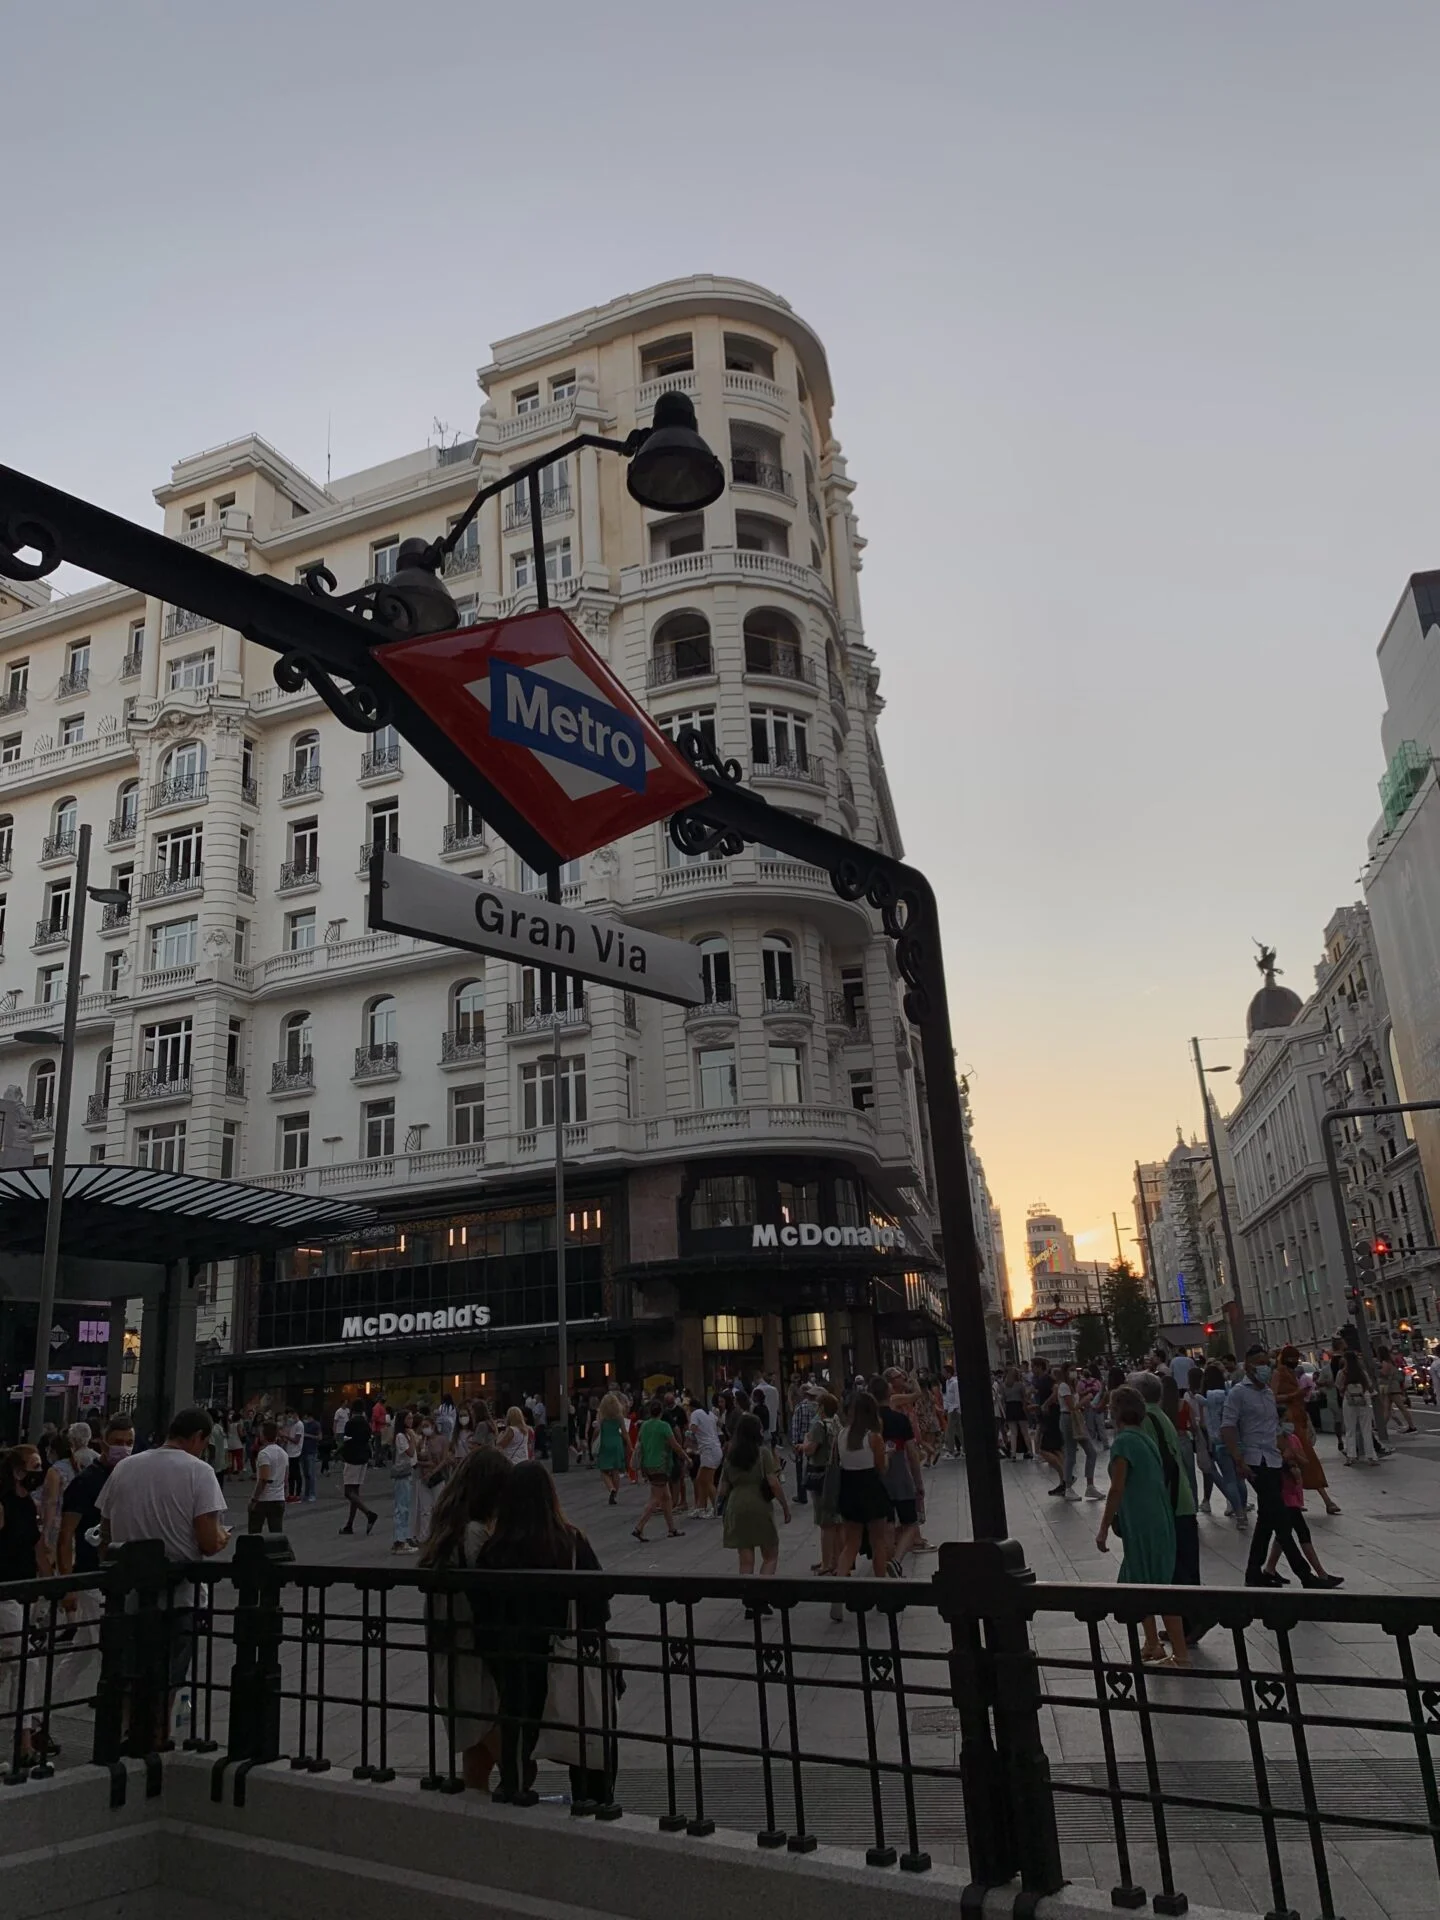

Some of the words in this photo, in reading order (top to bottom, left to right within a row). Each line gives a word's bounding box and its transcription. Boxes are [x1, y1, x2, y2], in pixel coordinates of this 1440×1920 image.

[506, 673, 637, 768] Metro
[476, 896, 576, 954] Gran
[592, 926, 646, 974] Via
[752, 1223, 906, 1248] McDonald's
[342, 1303, 491, 1338] McDonald's
